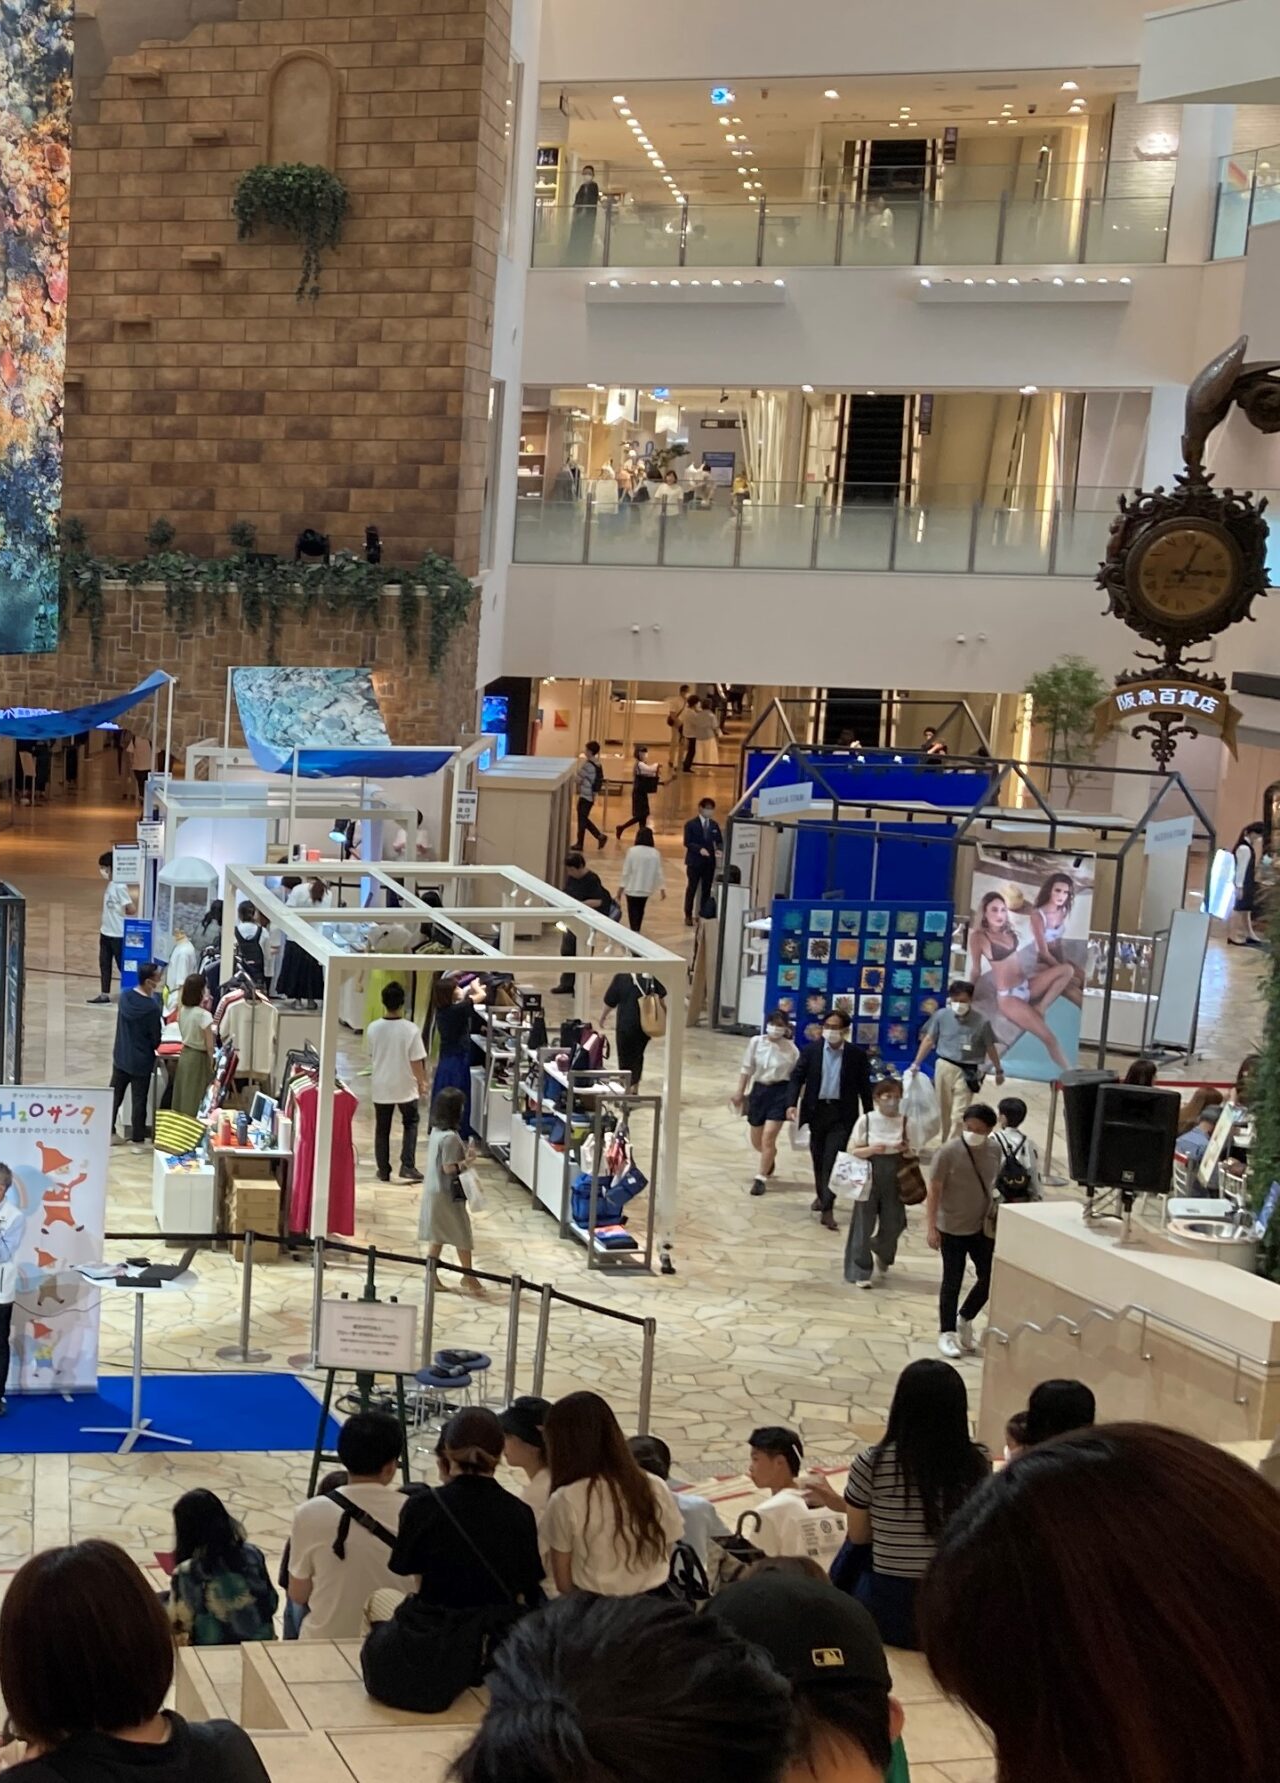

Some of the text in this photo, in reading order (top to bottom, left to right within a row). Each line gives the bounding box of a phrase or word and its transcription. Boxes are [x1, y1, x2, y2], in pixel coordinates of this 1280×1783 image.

[1116, 687, 1219, 715] 阪急百貨店
